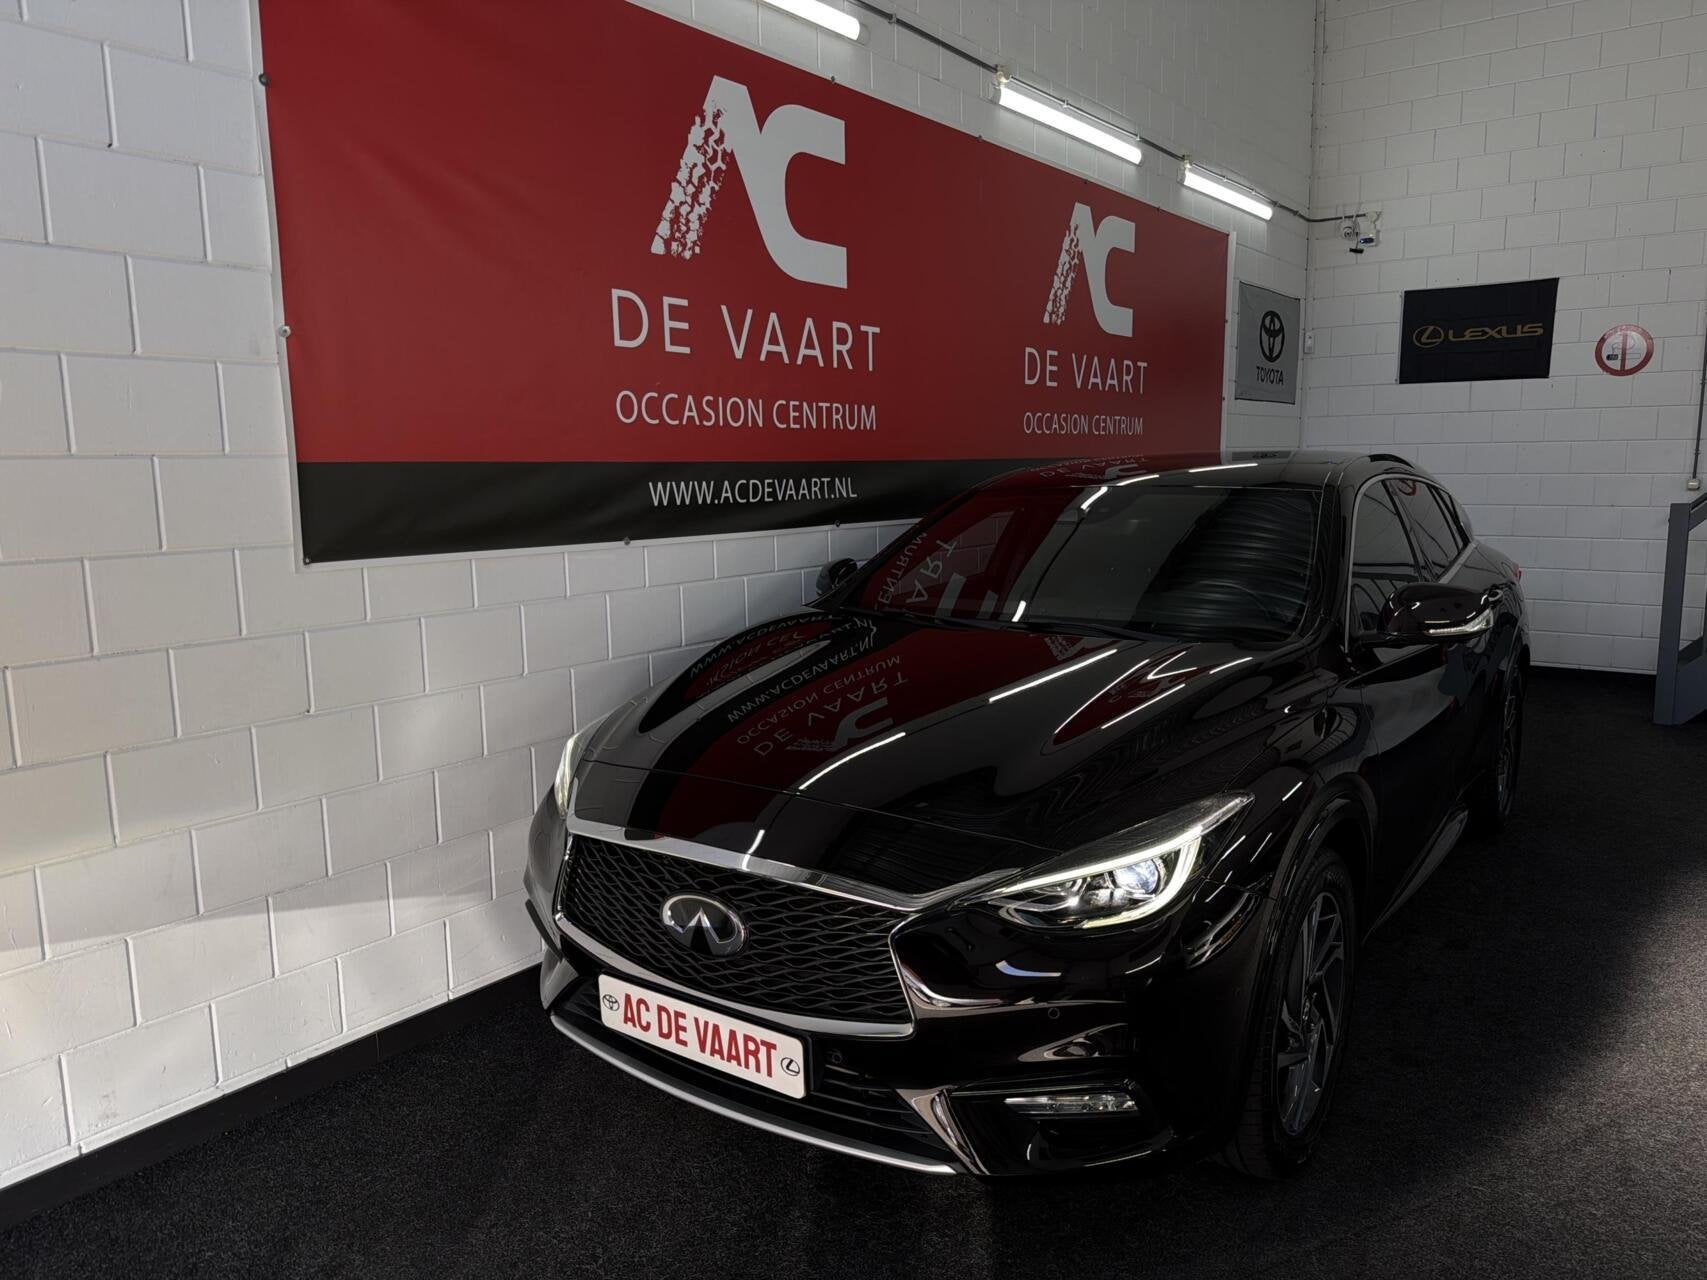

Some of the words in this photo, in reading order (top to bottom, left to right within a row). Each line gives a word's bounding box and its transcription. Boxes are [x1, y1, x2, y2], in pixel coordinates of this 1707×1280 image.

[611, 288, 691, 354] DE
[721, 304, 881, 372] VAART
[1448, 322, 1544, 341] LEXUS
[1024, 347, 1059, 387] DE
[1072, 353, 1148, 394] VAART
[1255, 366, 1284, 386] TOYOTA
[616, 390, 763, 427] OCCASION
[773, 400, 877, 431] CENTRUM
[1023, 412, 1089, 435] OCCASION
[1092, 415, 1143, 436] CENTRUM
[649, 477, 858, 507] WWW.ACDEVAART.NL
[623, 993, 651, 1033] AC
[656, 1004, 688, 1047] DE
[693, 1016, 777, 1078] VAART
